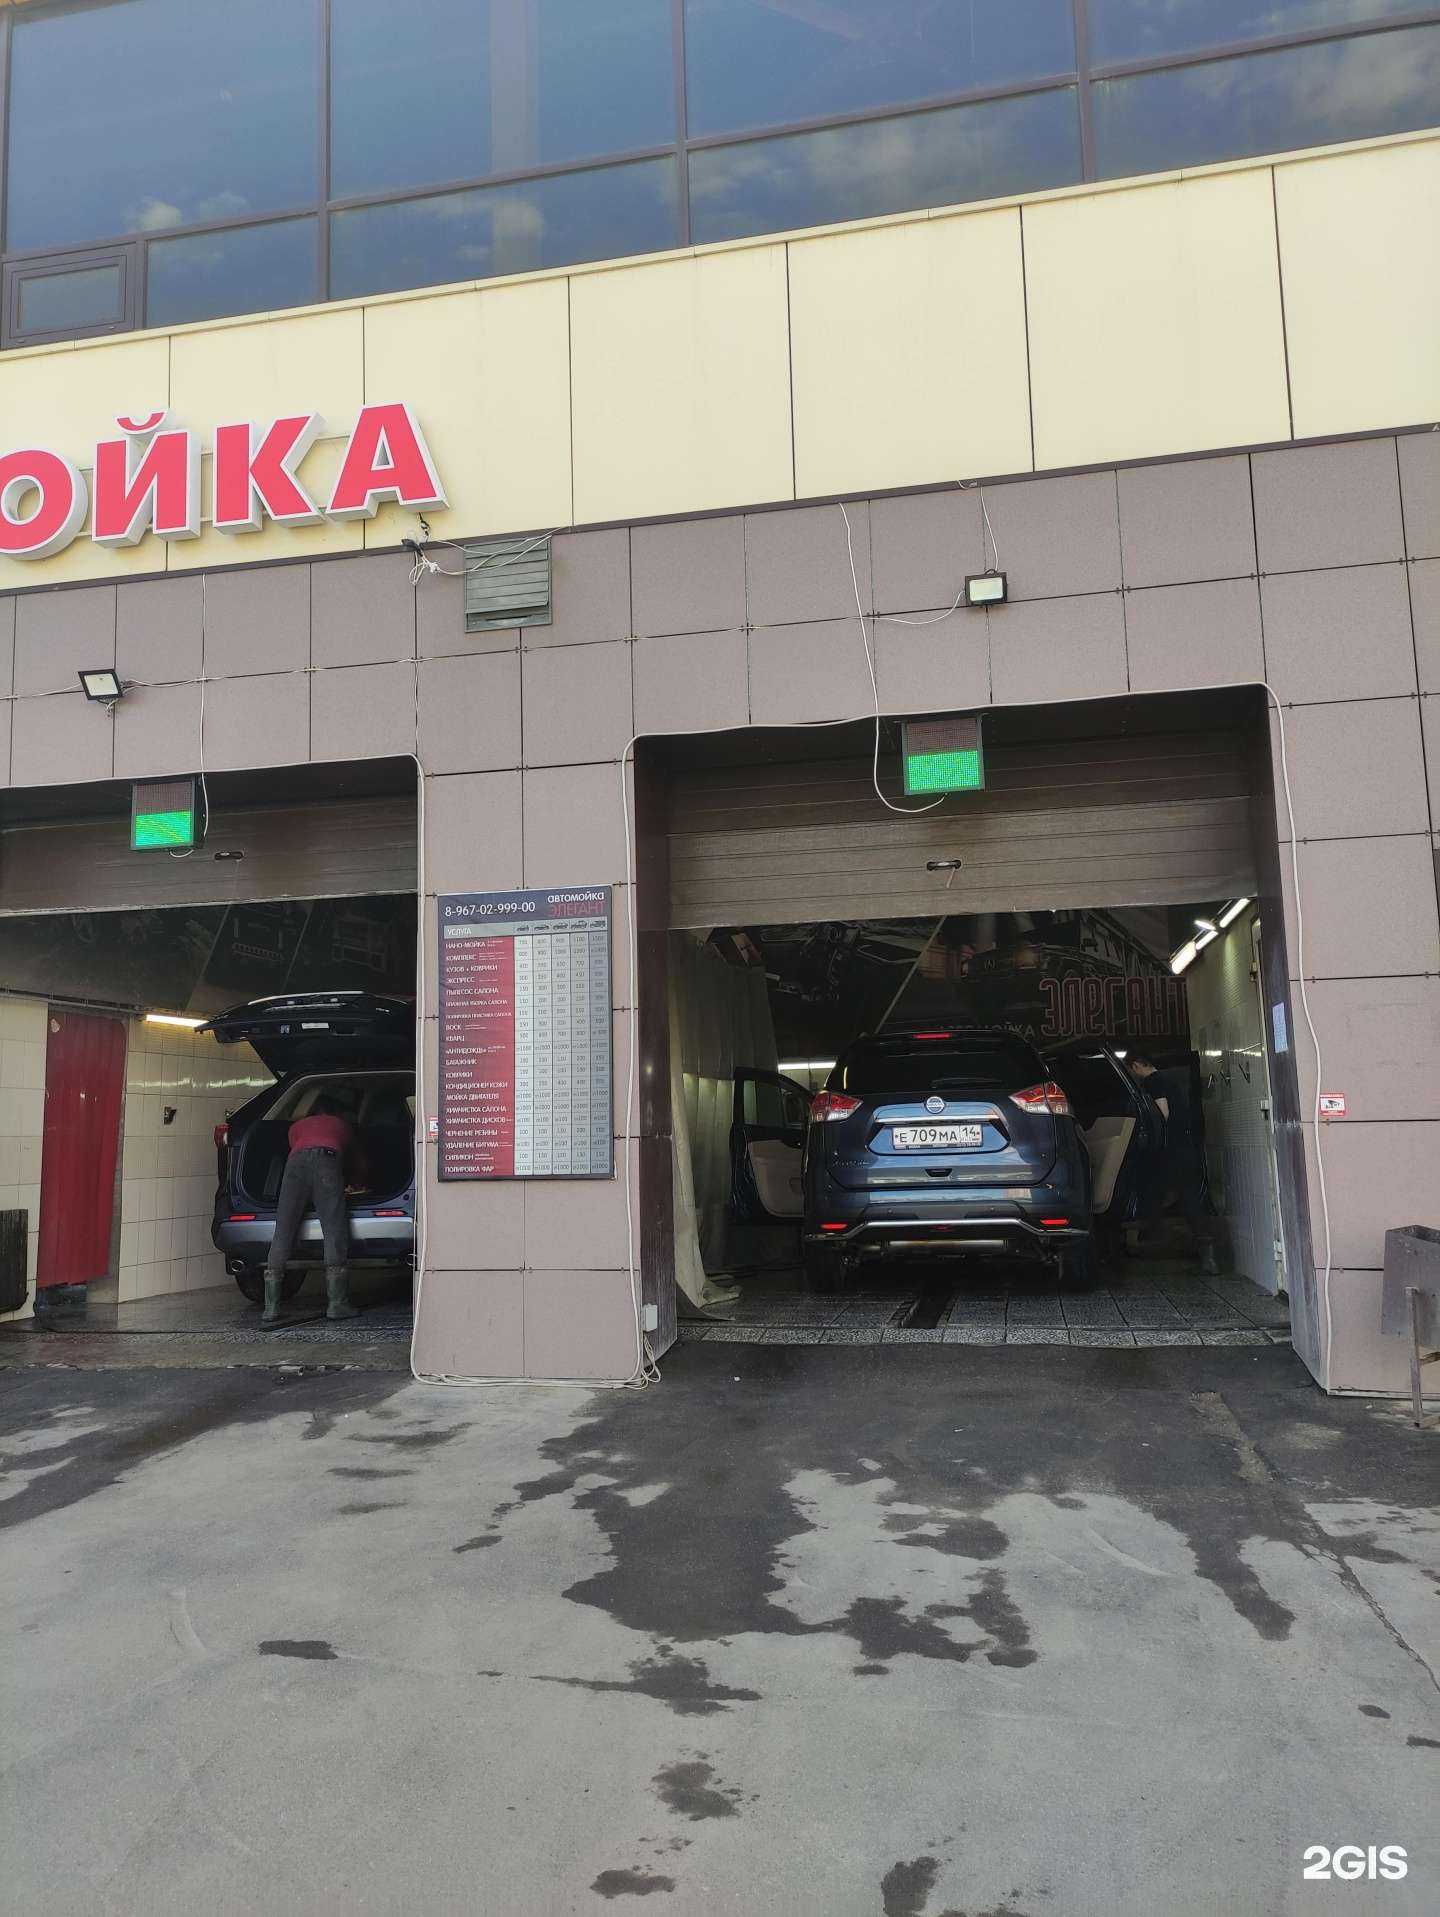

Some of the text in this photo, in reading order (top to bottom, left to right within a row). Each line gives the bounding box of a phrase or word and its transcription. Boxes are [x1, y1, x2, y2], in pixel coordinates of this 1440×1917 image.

[0, 402, 448, 558] ОЙКА
[548, 891, 604, 903] автомойка
[445, 902, 536, 916] 8-967-02-999-00
[548, 902, 604, 917] ЭЛЕГАНТ
[962, 1126, 976, 1137] 14
